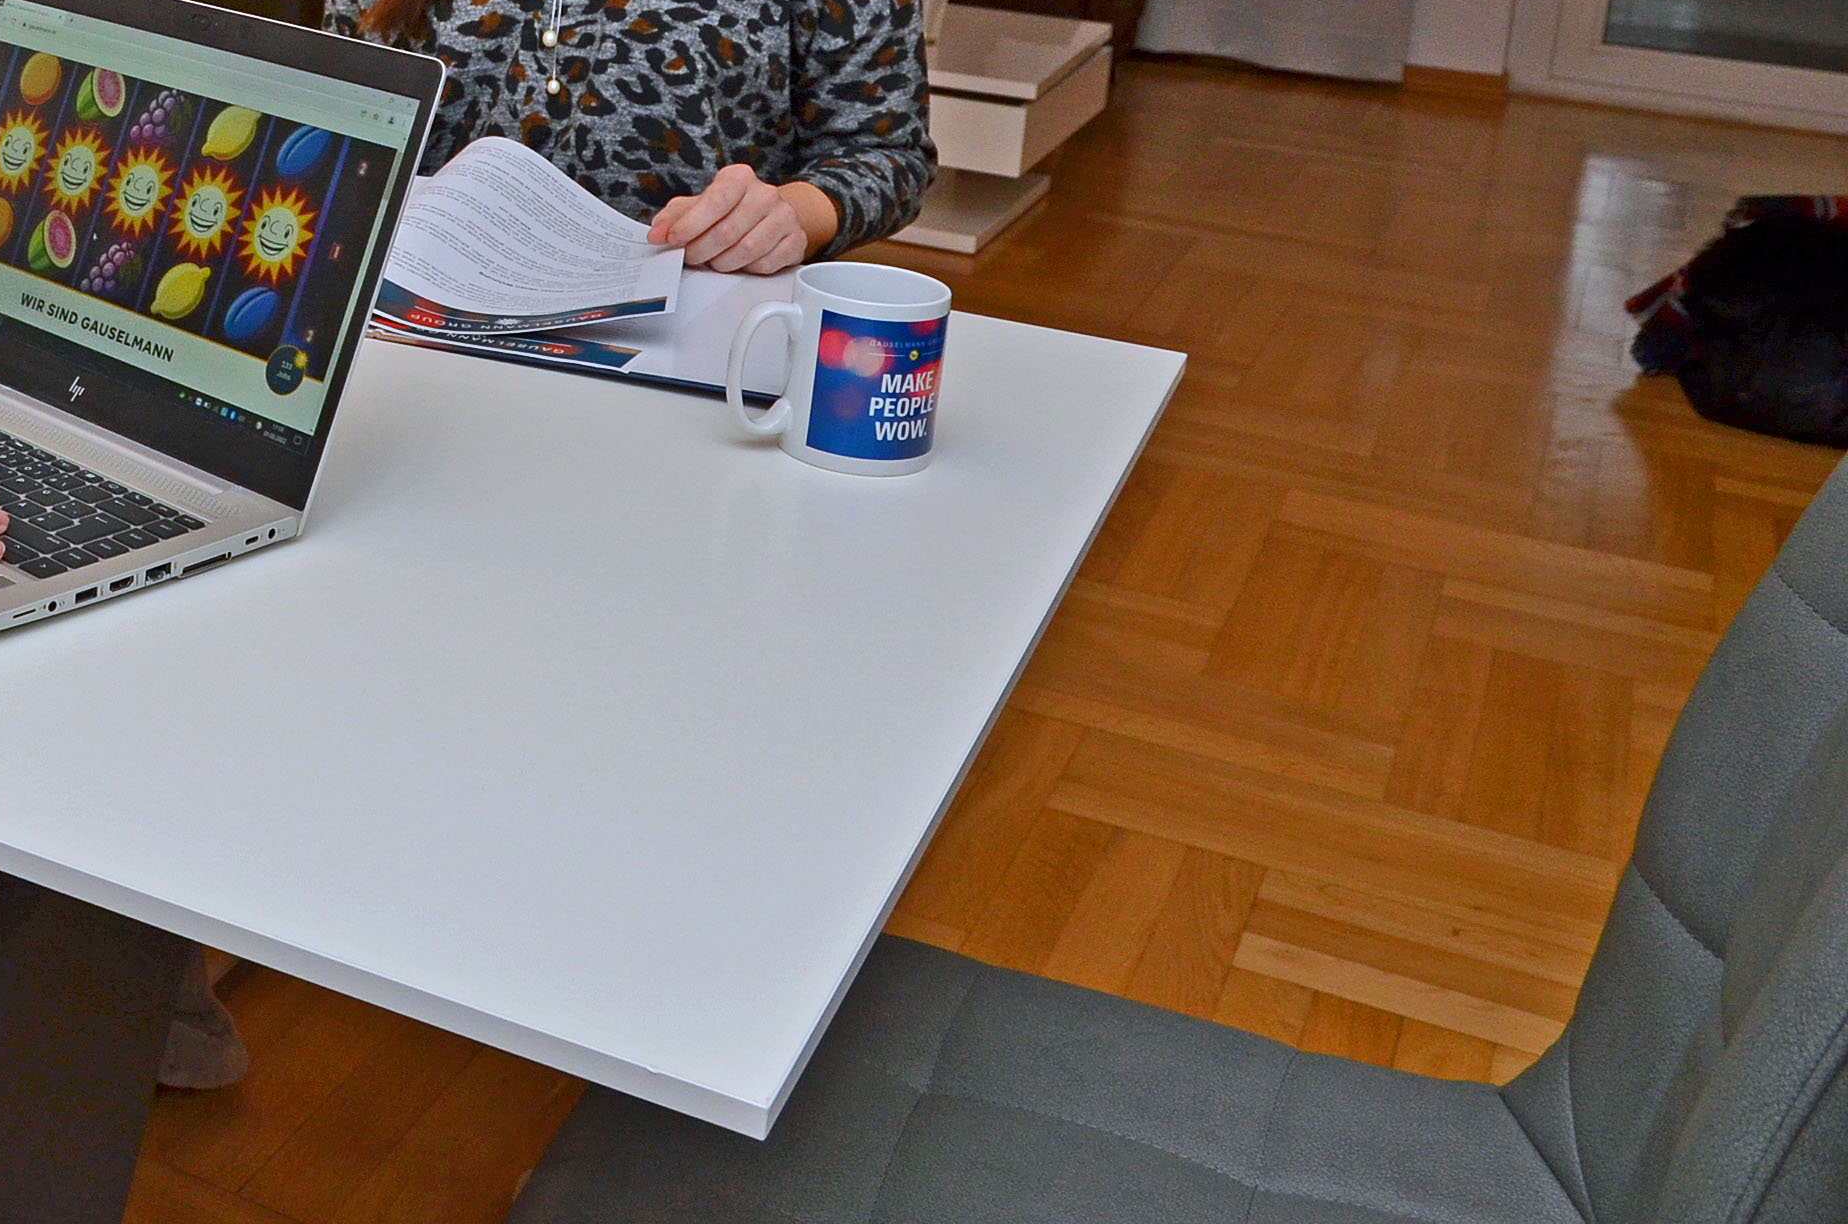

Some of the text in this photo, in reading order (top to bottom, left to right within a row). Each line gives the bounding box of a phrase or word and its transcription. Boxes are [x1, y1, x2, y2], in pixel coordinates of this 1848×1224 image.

[20, 292, 174, 363] WIR SIND GAUSELMANN
[410, 312, 472, 330] GROUP
[446, 330, 566, 356] GAUSELMANN
[880, 370, 934, 393] MAKE
[868, 393, 935, 417] PEOPLE
[874, 418, 928, 442] WOW.
